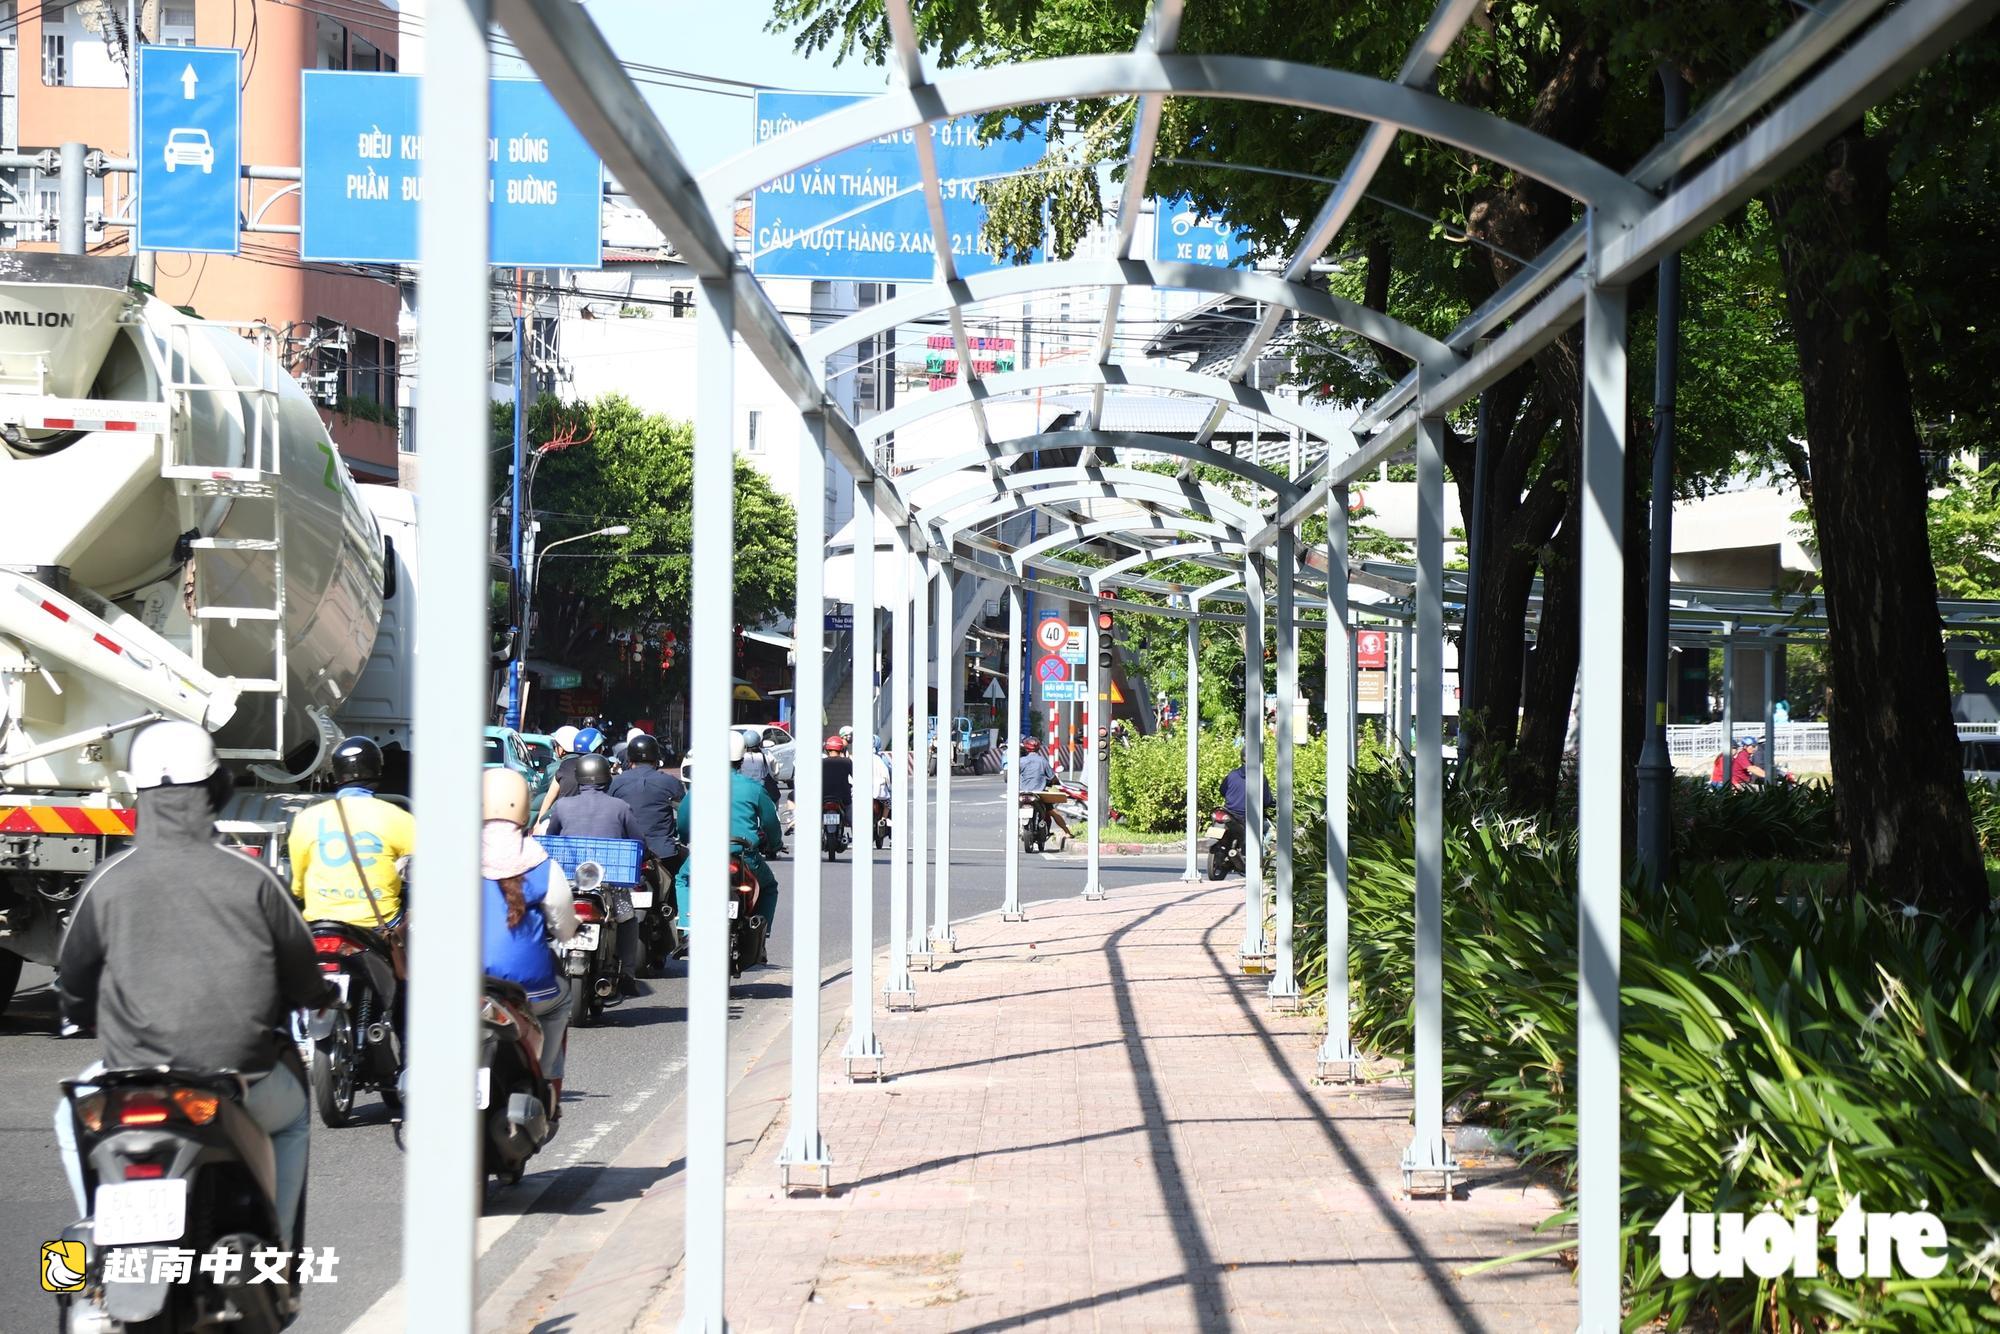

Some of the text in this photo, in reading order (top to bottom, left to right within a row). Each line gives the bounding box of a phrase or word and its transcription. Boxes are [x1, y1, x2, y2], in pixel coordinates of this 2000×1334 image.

[358, 124, 392, 159] ĐIỀU
[508, 132, 549, 163] ĐÚNG
[942, 125, 962, 147] 0,1
[346, 165, 389, 200] PHẦN
[506, 174, 558, 205] ĐƯỜNG
[801, 166, 836, 195] VĂN
[840, 167, 898, 197] THÁNH
[759, 216, 795, 250] CẦU
[800, 227, 845, 256] VƯỢT
[849, 224, 895, 252] HÀNG
[899, 232, 936, 254] XAN
[952, 233, 972, 256] 2,1
[1177, 243, 1193, 259] XE
[1215, 240, 1229, 260] VÀ
[0, 310, 75, 328] MLION
[1046, 627, 1060, 640] 40
[318, 817, 383, 868] be
